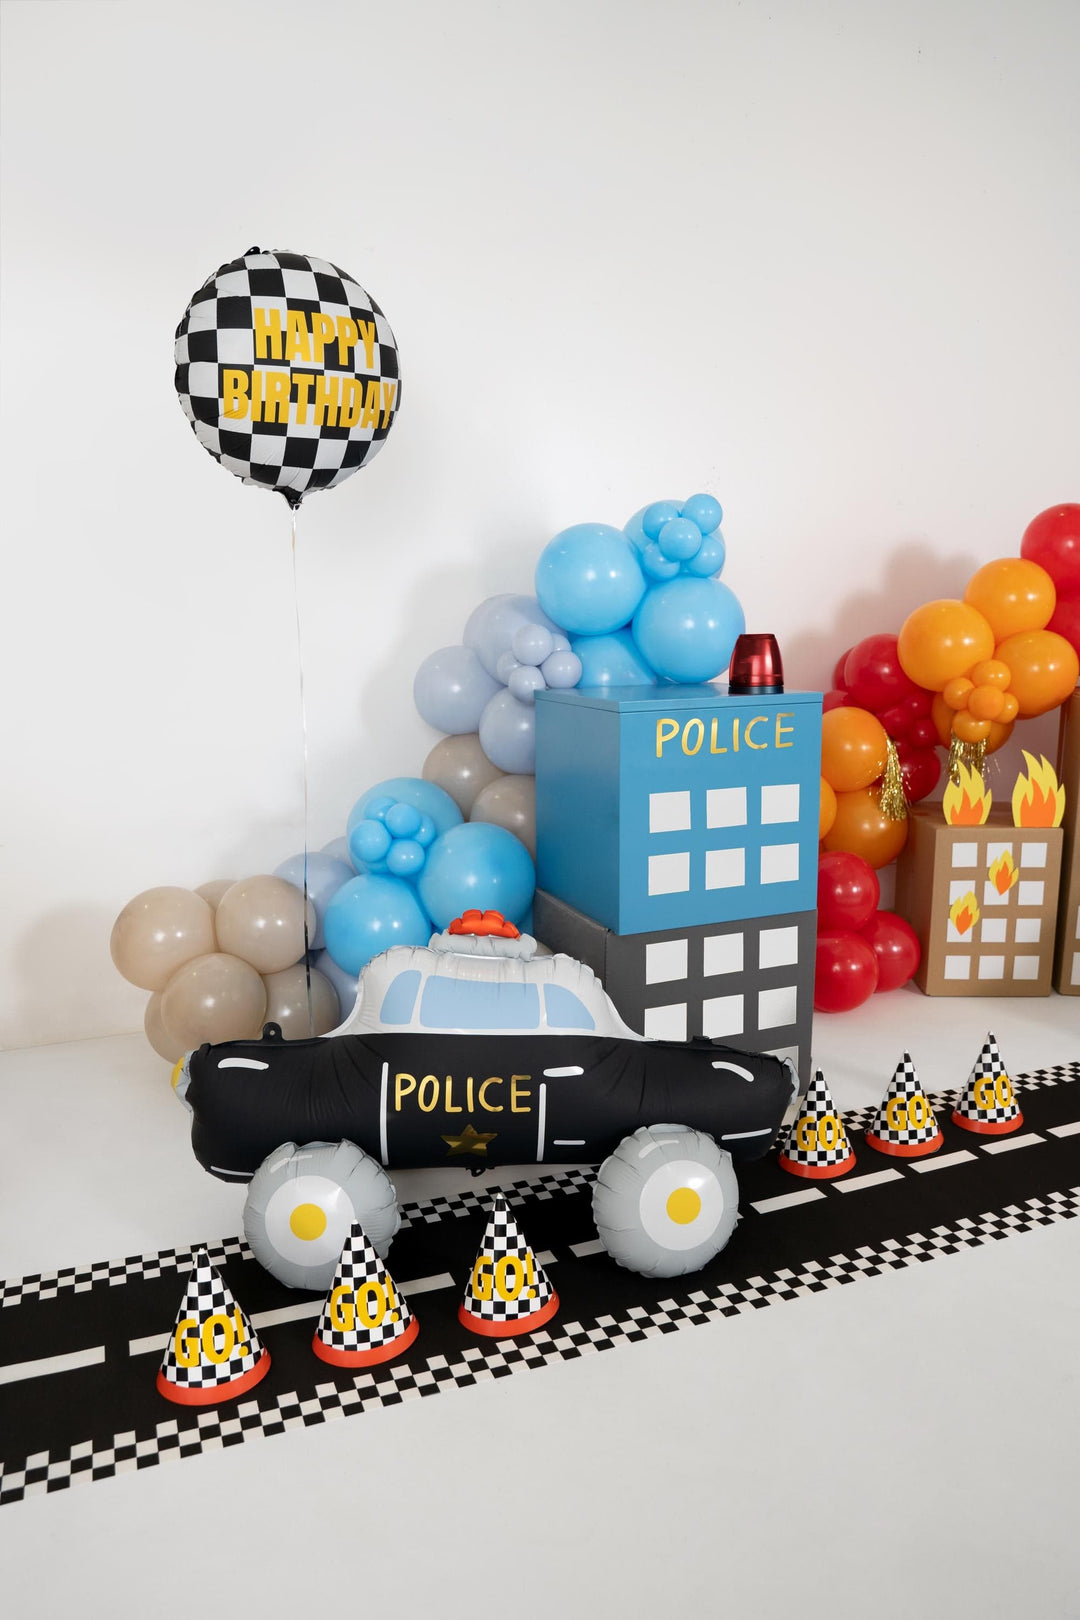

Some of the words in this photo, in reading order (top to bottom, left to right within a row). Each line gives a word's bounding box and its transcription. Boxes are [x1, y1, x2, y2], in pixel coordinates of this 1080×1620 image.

[254, 307, 376, 370] HAPPY
[222, 369, 397, 430] BIRTHDAY
[656, 712, 795, 758] POLICE
[395, 1073, 532, 1113] POLICE
[796, 1114, 847, 1152] GO!
[329, 1274, 400, 1333] GO!
[472, 1252, 537, 1301] GO!
[174, 1307, 249, 1368] GO!
